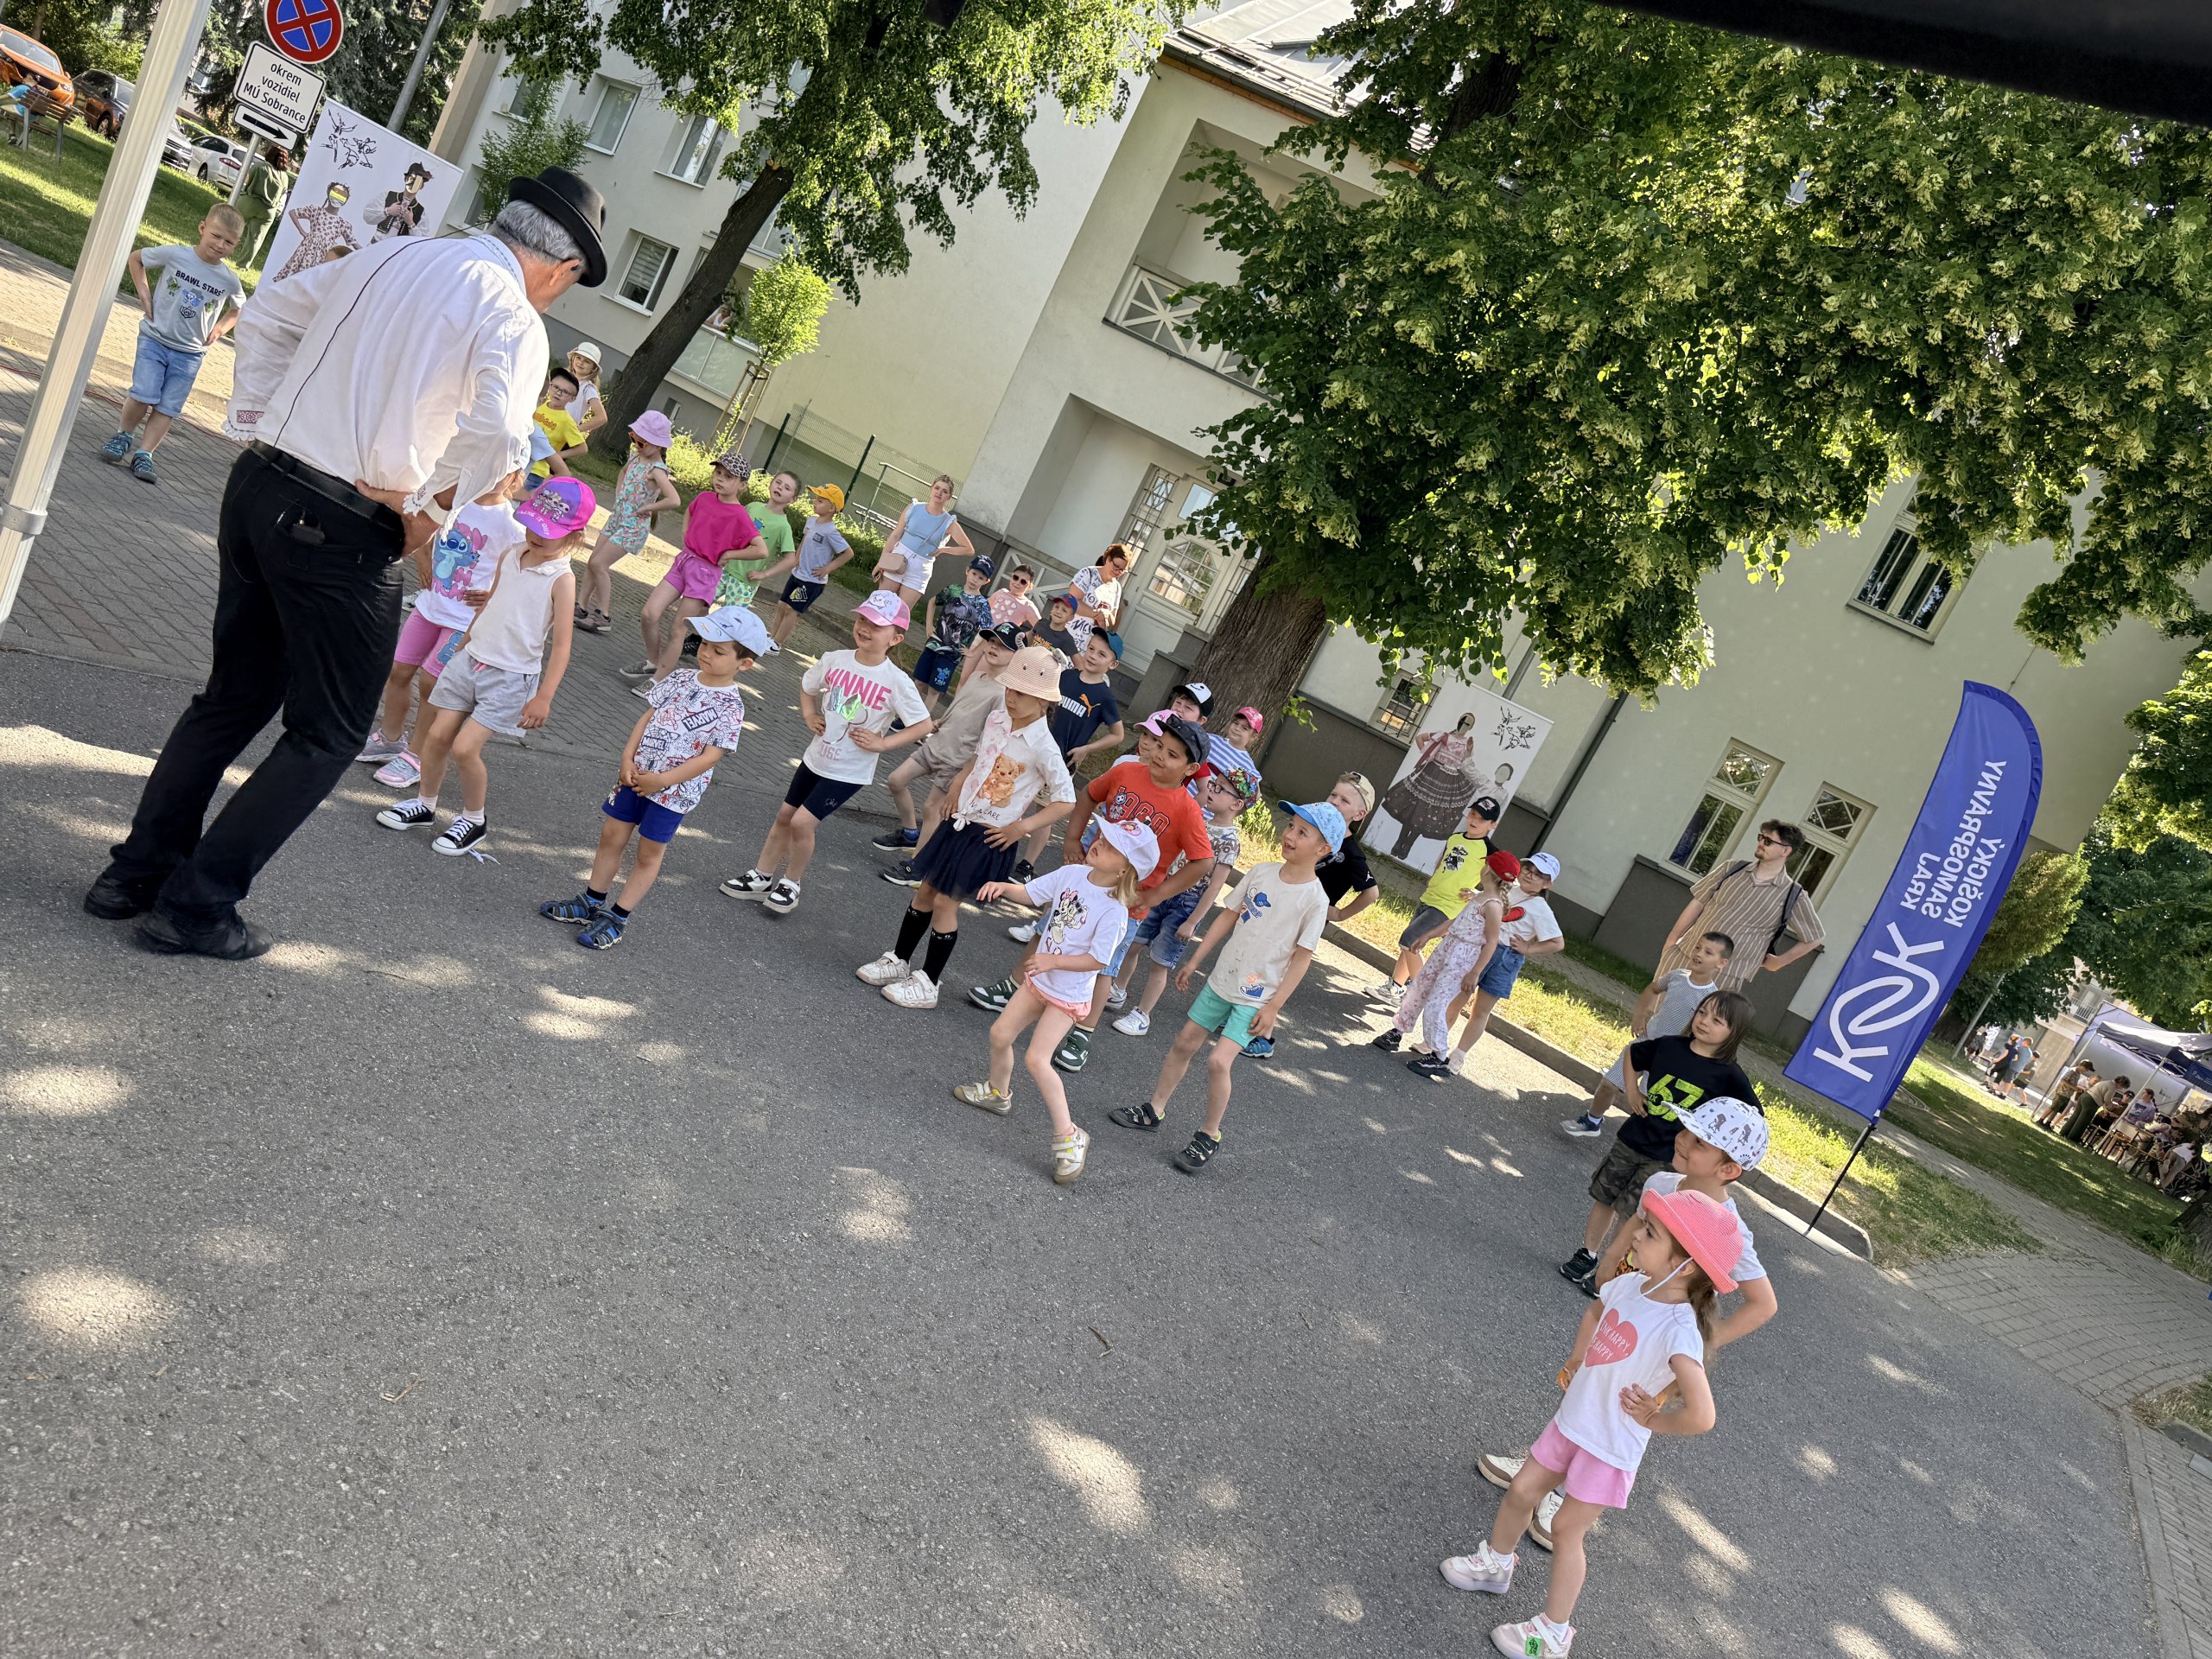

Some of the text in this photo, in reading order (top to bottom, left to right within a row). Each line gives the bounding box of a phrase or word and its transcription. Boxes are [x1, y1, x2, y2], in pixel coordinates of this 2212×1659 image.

[270, 63, 302, 86] okrem
[262, 76, 301, 103] vozidiel
[243, 82, 306, 124] MÚ Sobrance
[175, 270, 222, 296] BRAWL STARS
[824, 667, 893, 710] MINNIE
[1058, 695, 1087, 717] PUMA
[683, 708, 718, 731] MARVEL
[642, 736, 665, 750] MARVEL
